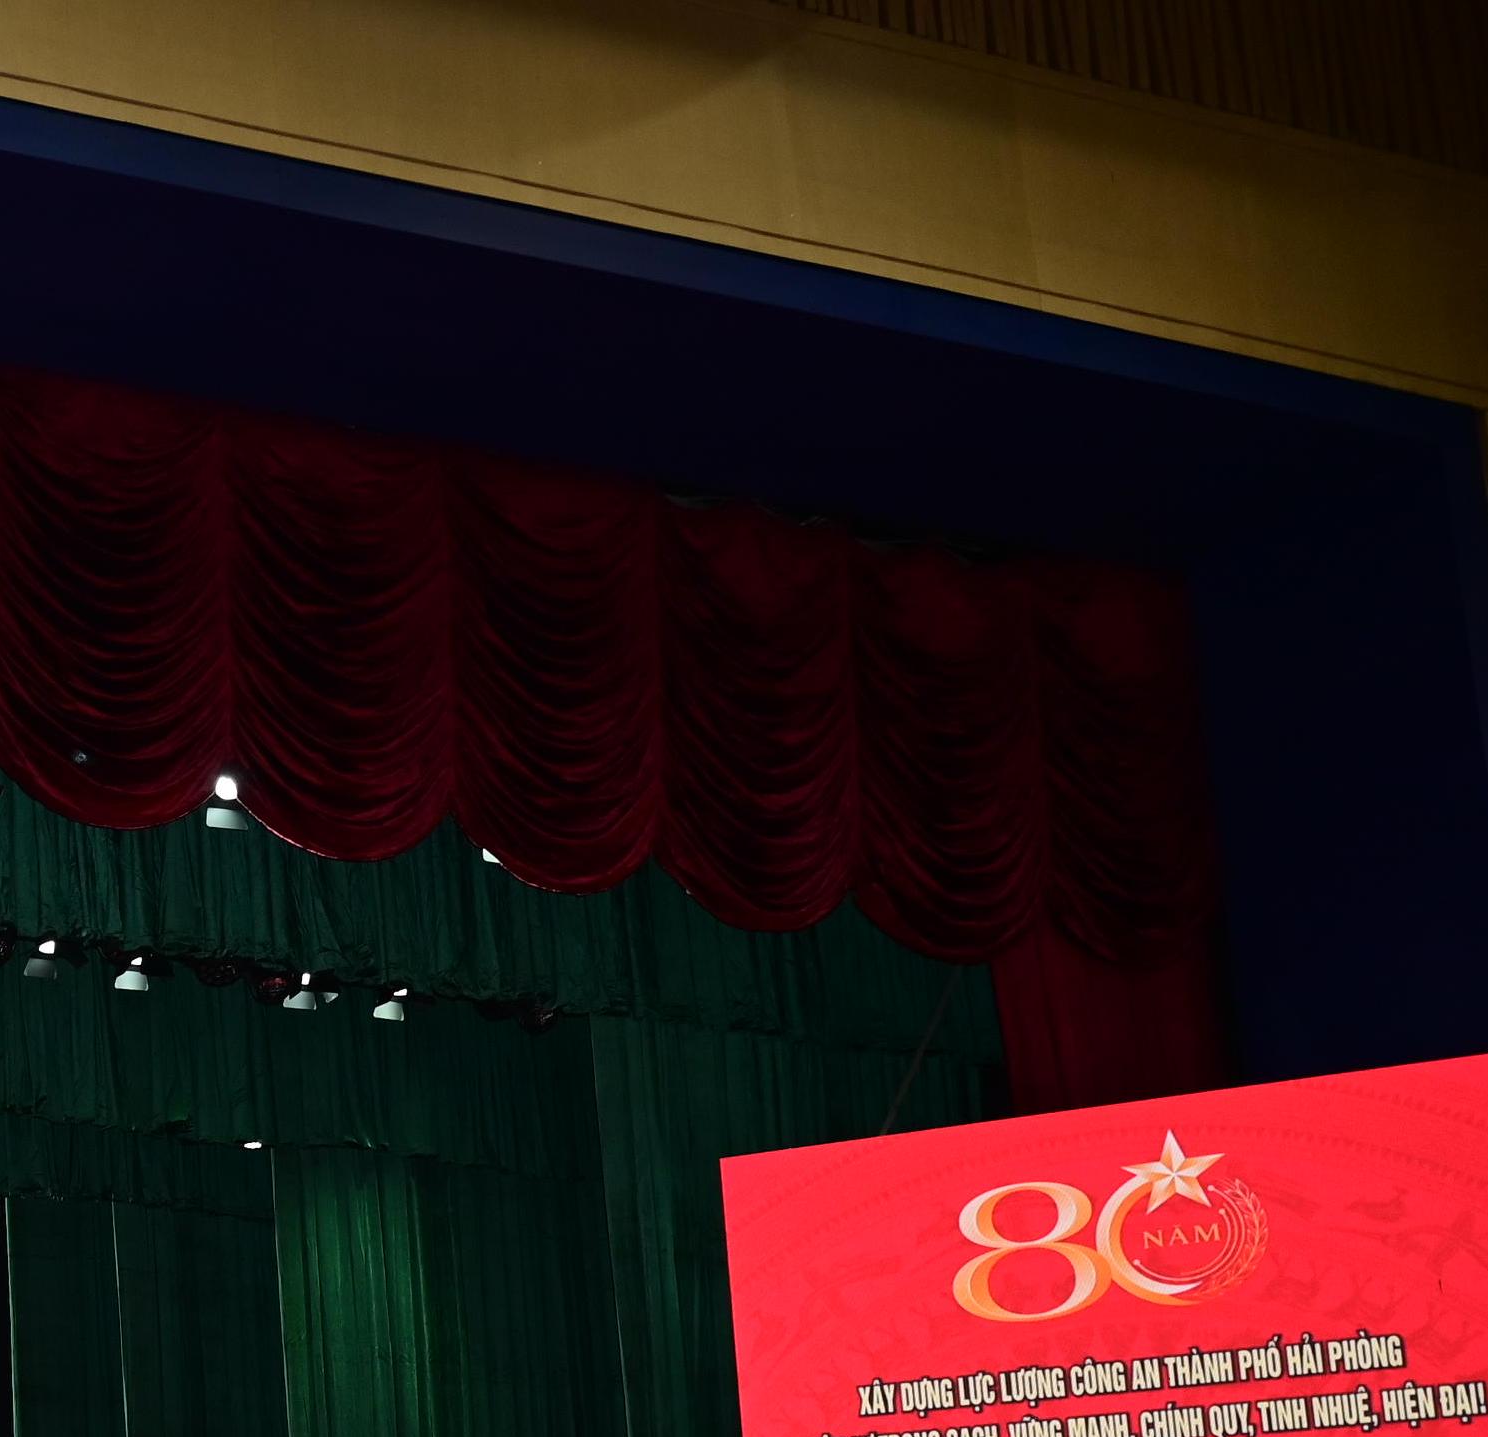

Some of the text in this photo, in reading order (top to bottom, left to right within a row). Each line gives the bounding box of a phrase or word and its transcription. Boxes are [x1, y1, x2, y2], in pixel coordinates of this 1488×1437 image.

[858, 1331, 1403, 1417] XÂY DỰNG LỰC LƯỢNG CÔNG AN THÀNH PHỐ HẢI PHÒNG
[1257, 1398, 1308, 1432] TINH
[1311, 1386, 1378, 1431] NHUỆ,
[1381, 1382, 1436, 1427] HIỆN
[1439, 1382, 1487, 1422] ĐẠI!
